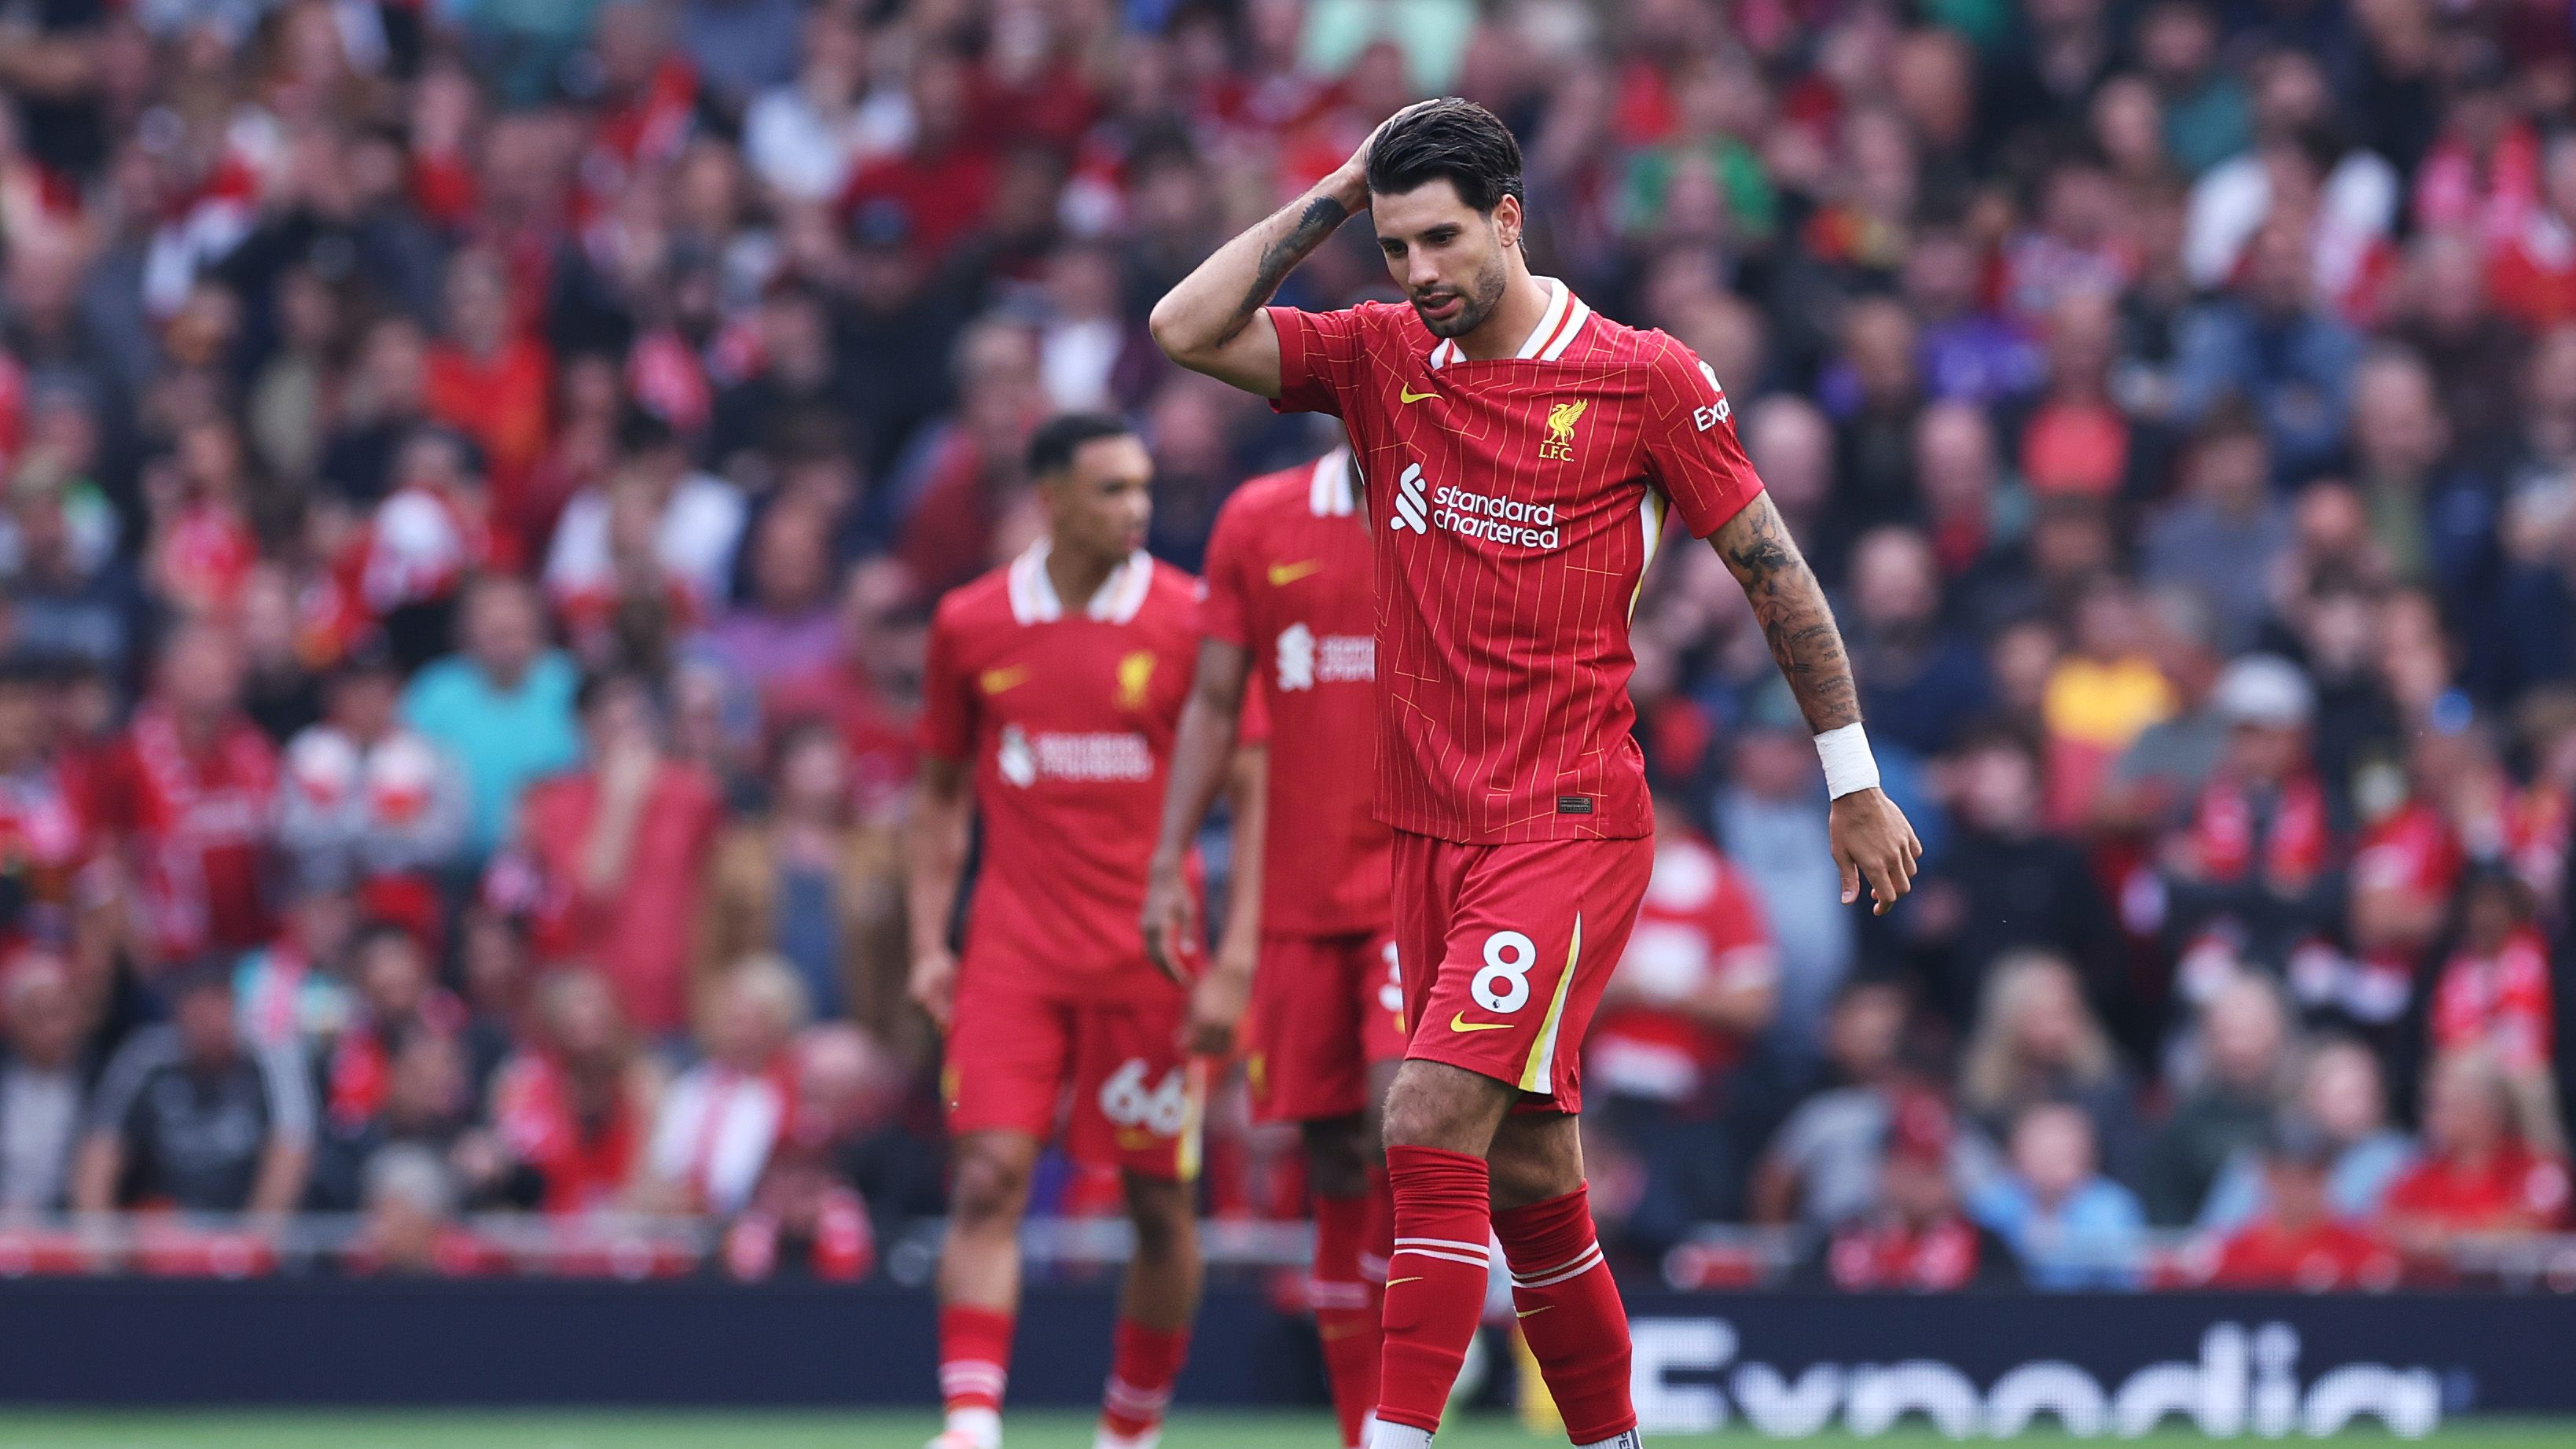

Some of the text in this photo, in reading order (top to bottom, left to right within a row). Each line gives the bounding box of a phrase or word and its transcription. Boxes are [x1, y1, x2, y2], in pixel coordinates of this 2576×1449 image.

[1538, 443, 1575, 462] L.F.C.
[1434, 485, 1555, 527] standard
[1433, 507, 1559, 549] chartered
[1470, 930, 1537, 1013] 8
[1099, 1057, 1190, 1133] 66
